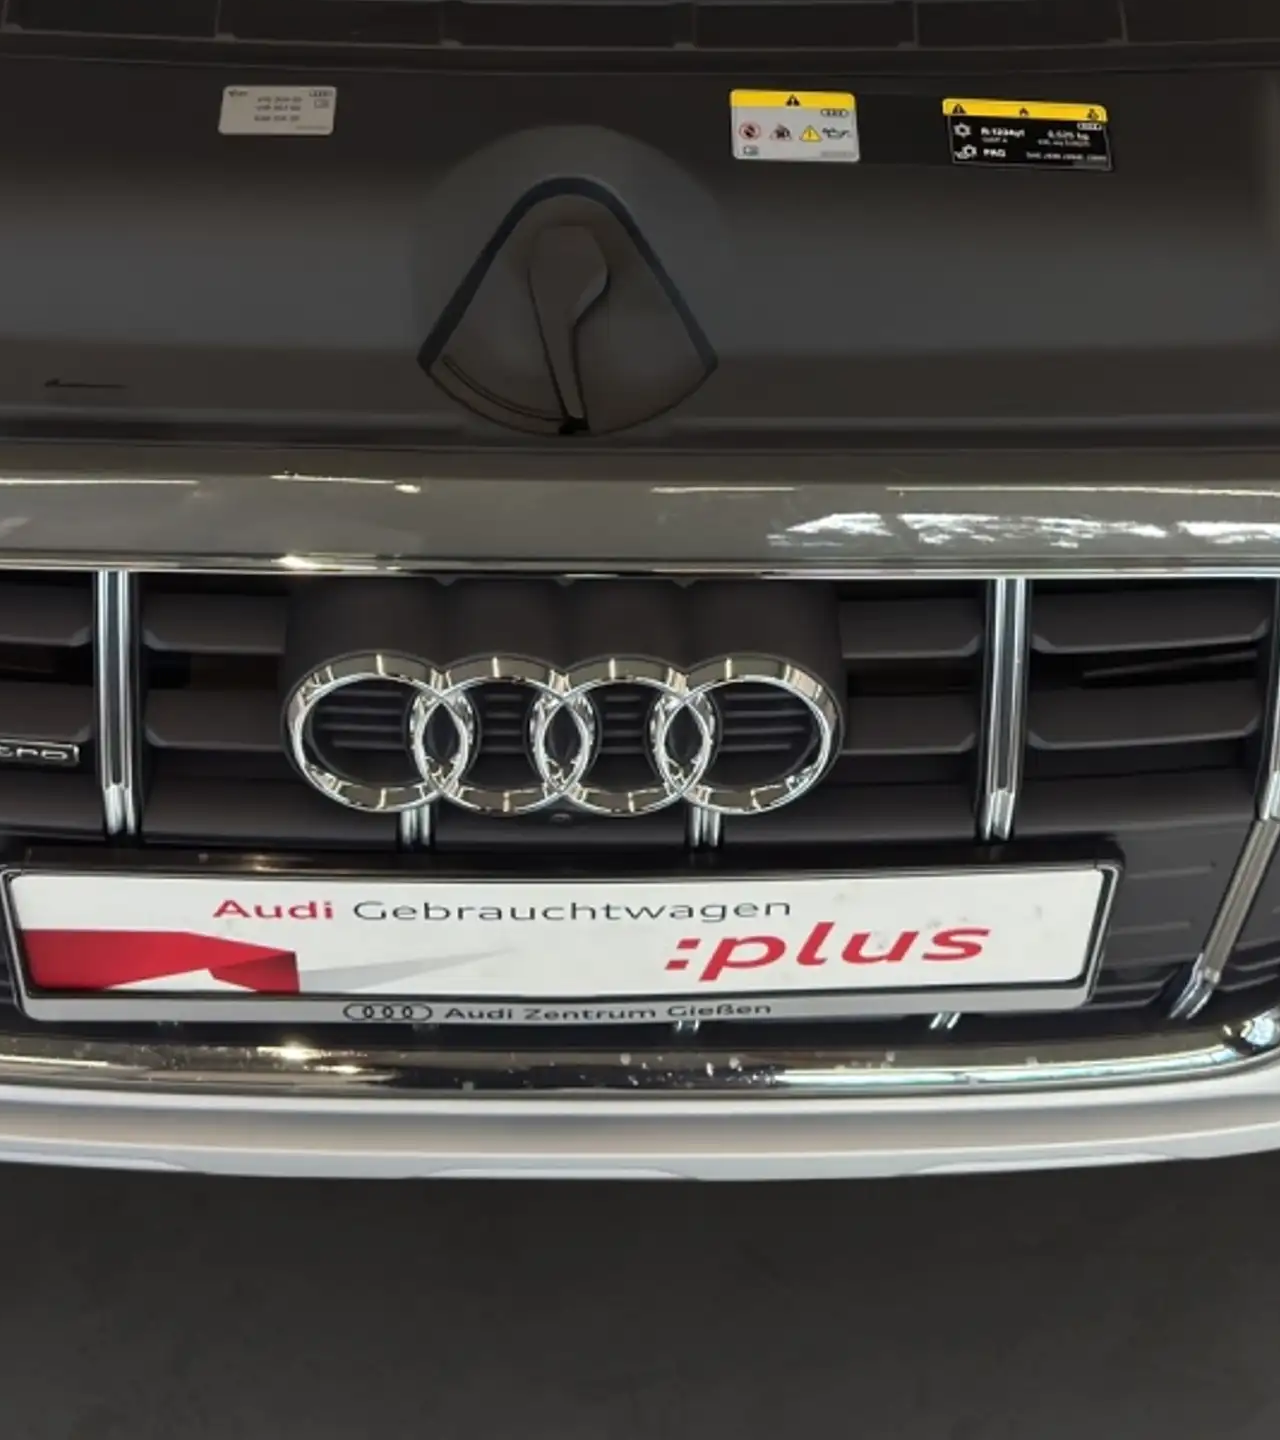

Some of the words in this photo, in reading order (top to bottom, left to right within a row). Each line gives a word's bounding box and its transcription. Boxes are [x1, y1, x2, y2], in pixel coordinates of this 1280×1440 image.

[213, 900, 334, 920] Audi
[353, 901, 791, 924] Gebrauchtwagen
[664, 921, 991, 983] :plus
[444, 1007, 514, 1021] Audi
[523, 1007, 657, 1021] Zentrum
[666, 1003, 772, 1019] Gießen
